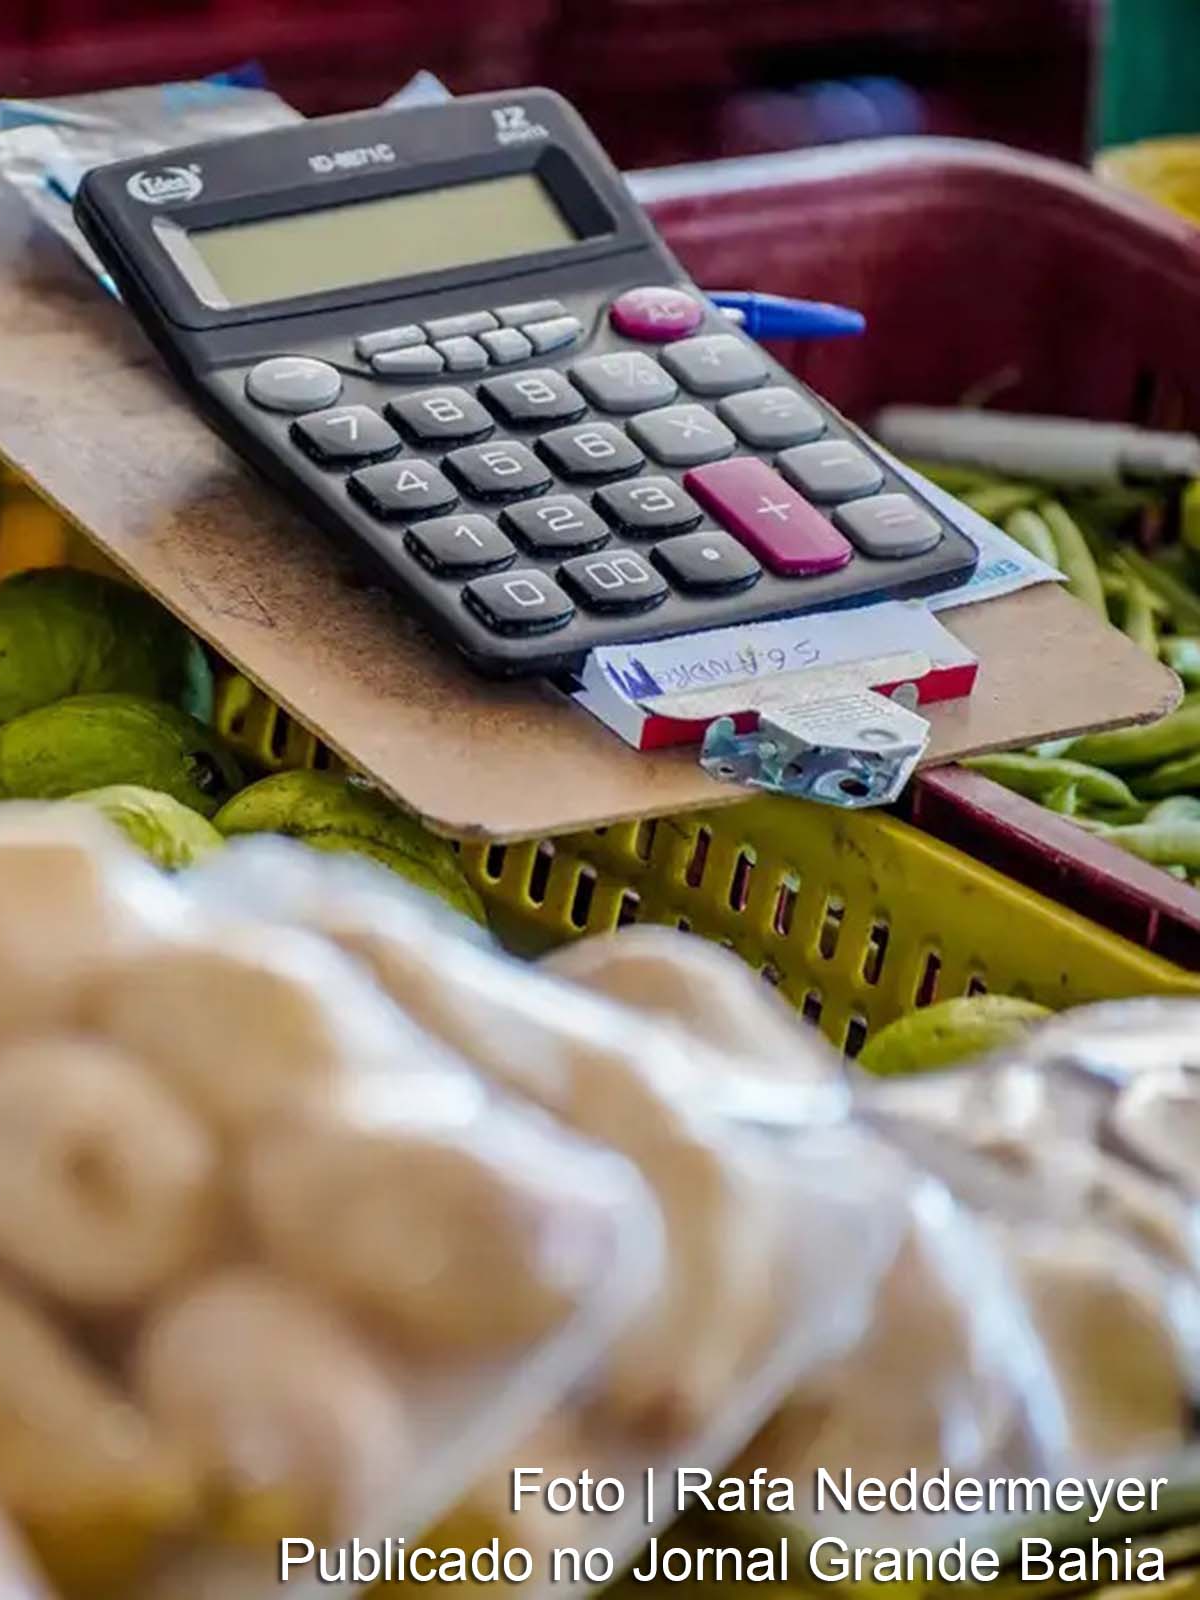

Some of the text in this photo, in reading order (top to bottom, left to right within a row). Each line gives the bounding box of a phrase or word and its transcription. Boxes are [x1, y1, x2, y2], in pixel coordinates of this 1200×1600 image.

[492, 106, 528, 129] 12
[326, 415, 357, 440] 7
[423, 399, 464, 422] 8
[398, 469, 429, 492] 4
[480, 450, 523, 475] 5
[573, 432, 616, 458] 6
[454, 523, 484, 547] 1
[536, 506, 585, 532] 2
[629, 486, 676, 512] 3
[504, 579, 546, 608] 0
[585, 556, 650, 590] 00
